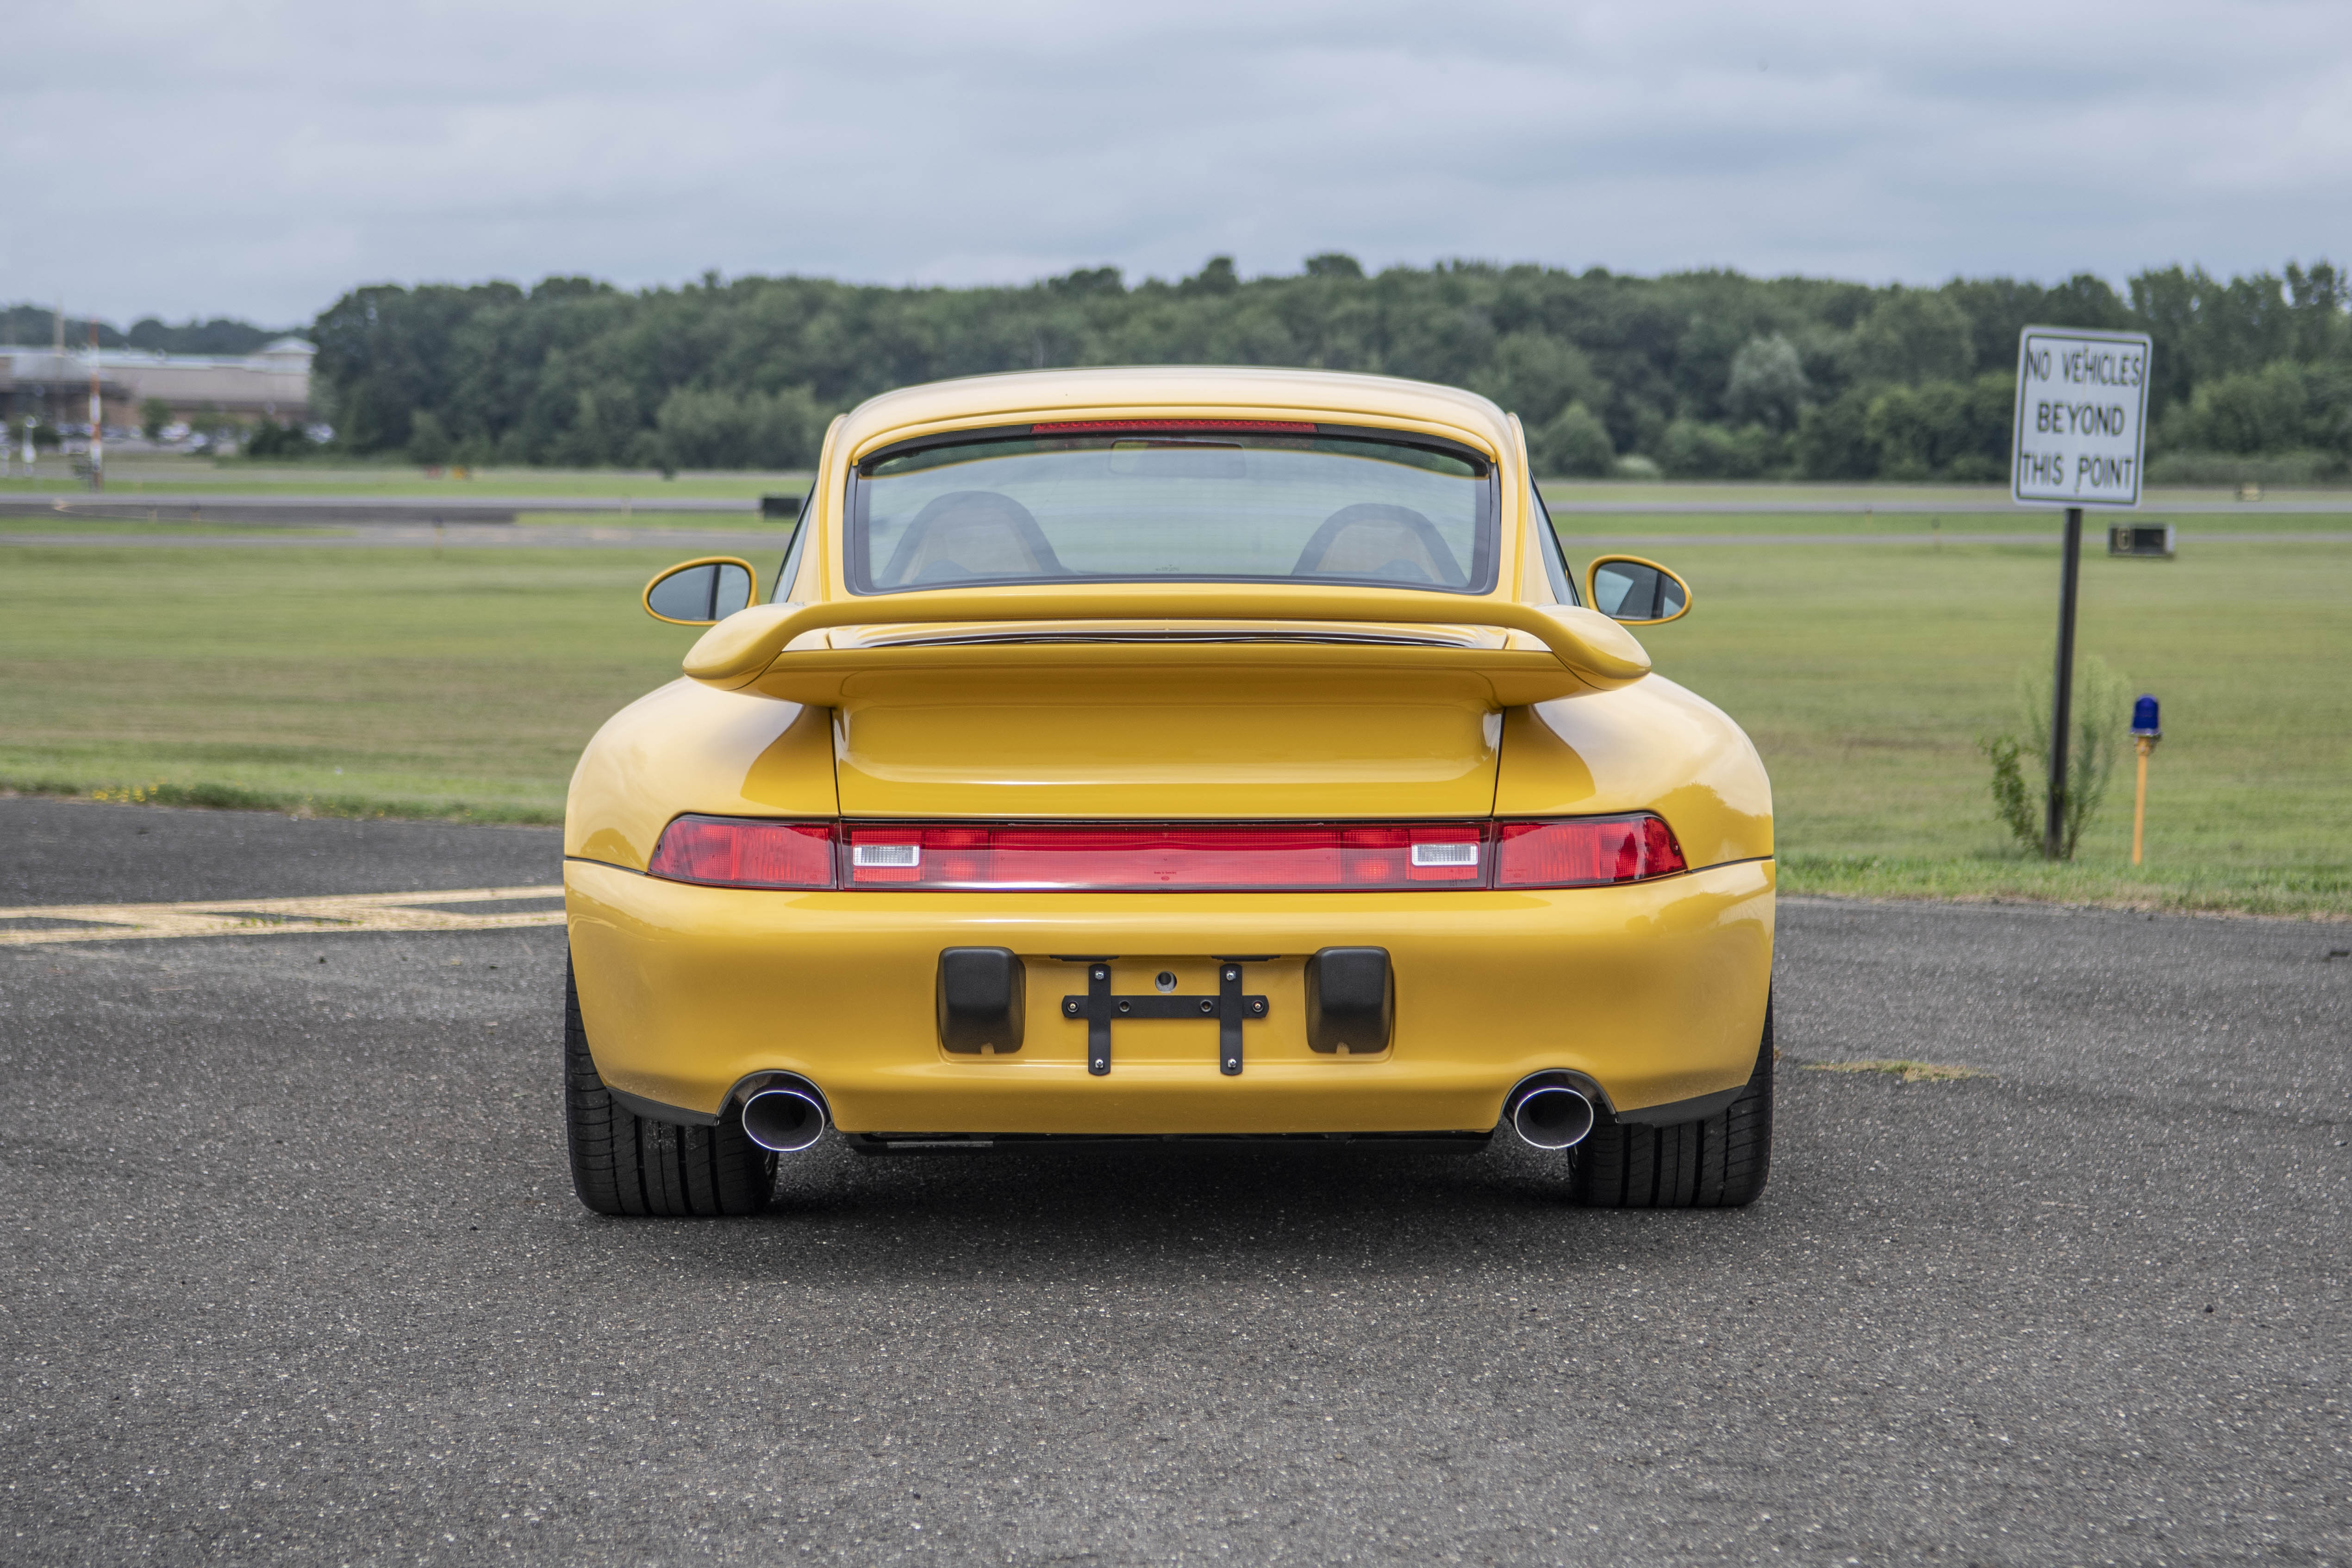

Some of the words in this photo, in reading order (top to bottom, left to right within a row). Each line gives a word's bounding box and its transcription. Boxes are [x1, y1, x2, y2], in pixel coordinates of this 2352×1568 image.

[2026, 349, 2052, 381] NO
[2062, 352, 2142, 387] VEHICLES
[2037, 402, 2125, 437] BEYOND
[2021, 452, 2064, 487] THIS
[2077, 454, 2134, 488] POINT
